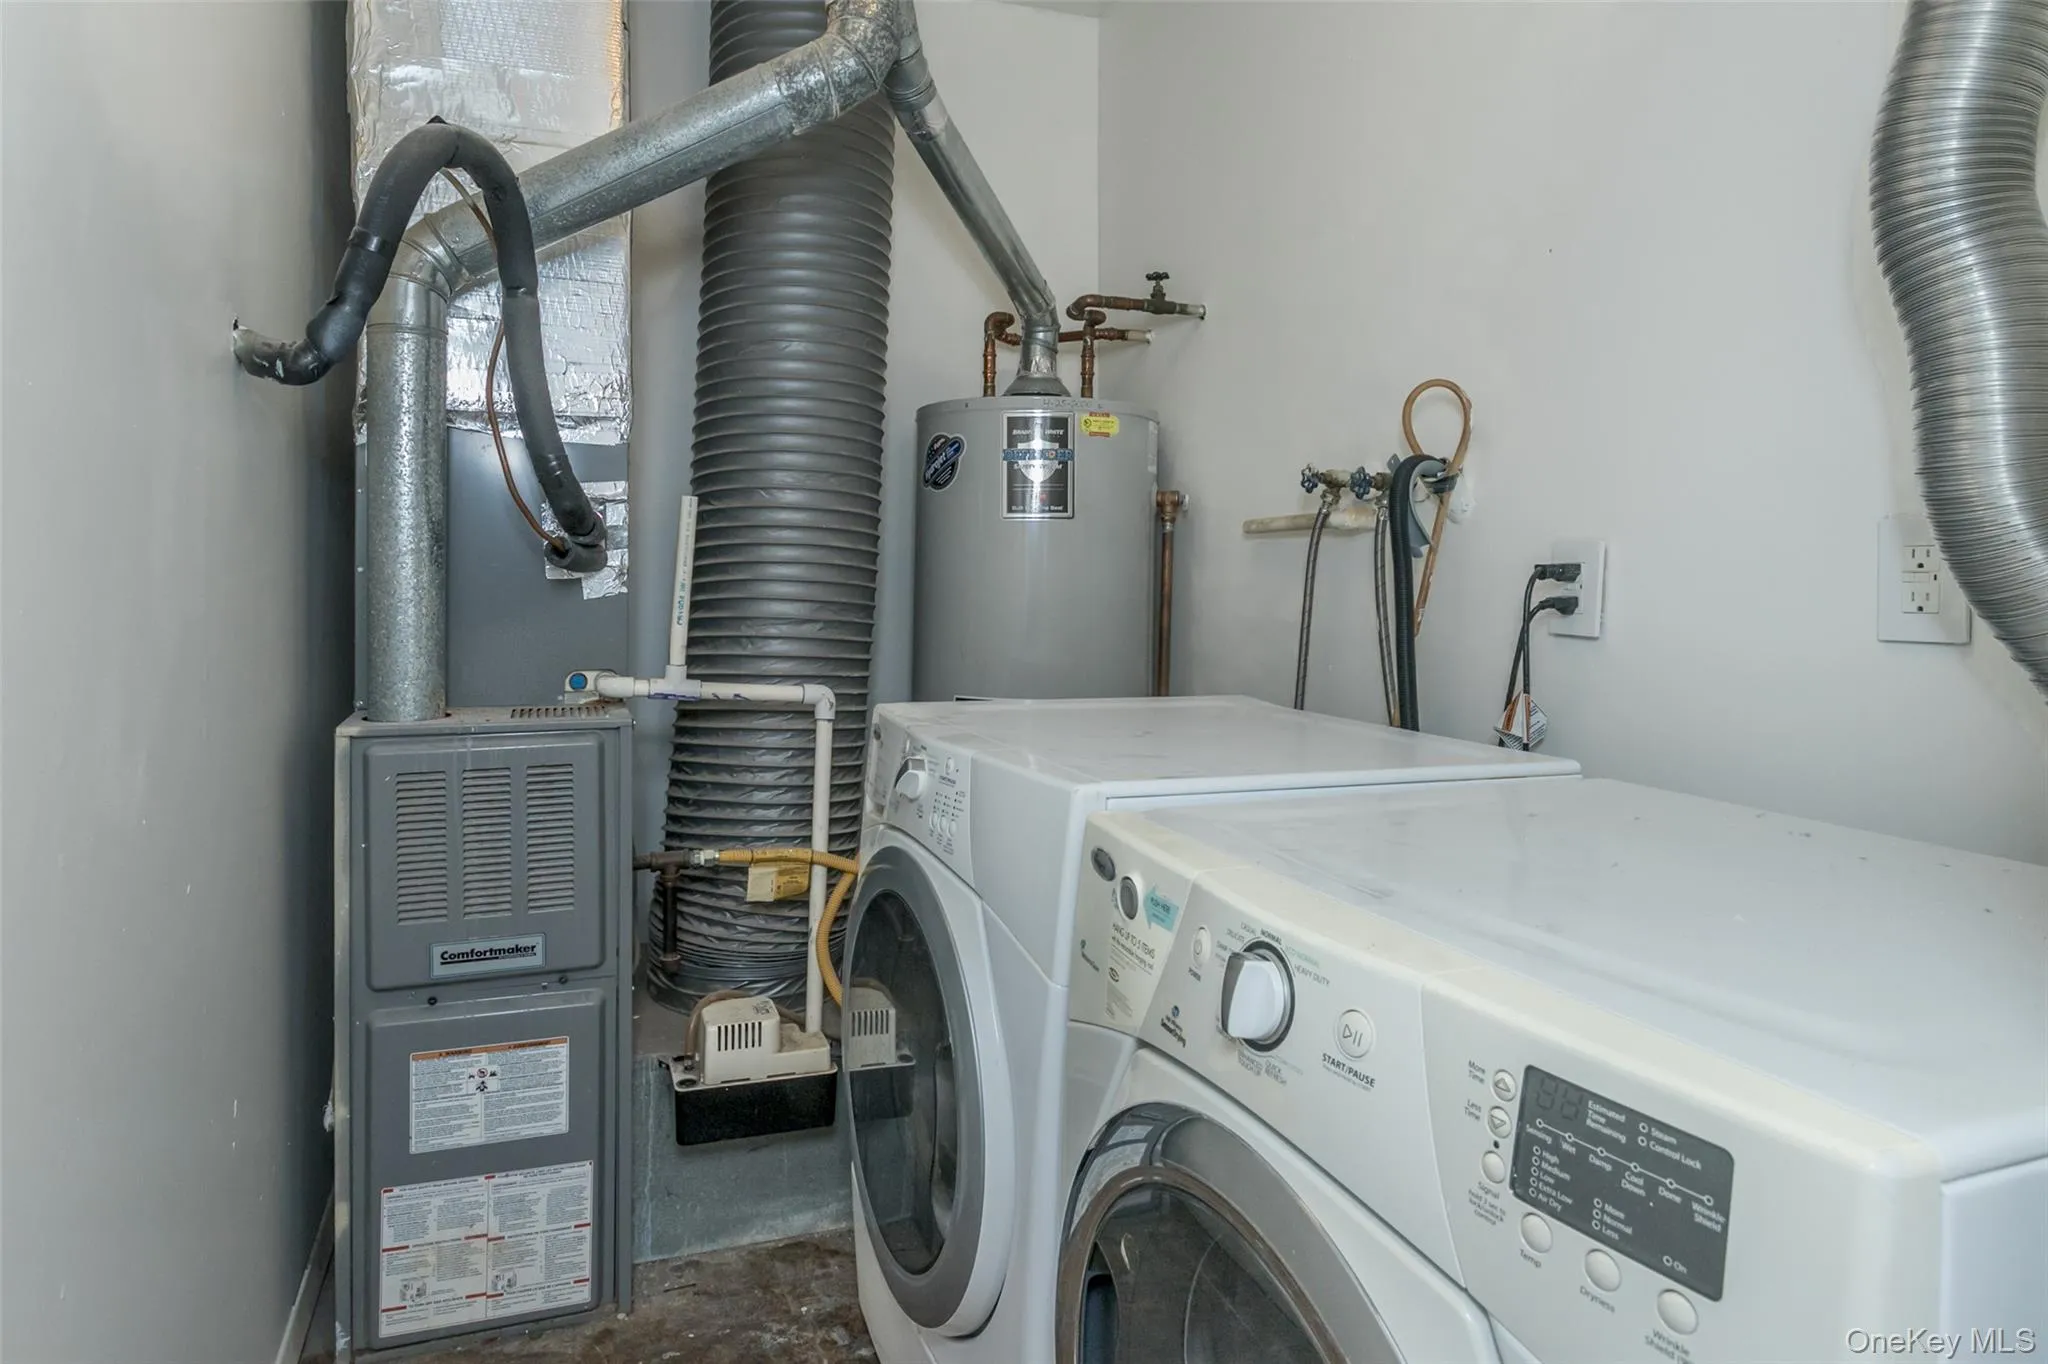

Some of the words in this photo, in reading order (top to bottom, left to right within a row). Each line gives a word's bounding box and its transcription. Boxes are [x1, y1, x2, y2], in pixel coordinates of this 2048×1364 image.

[1260, 929, 1282, 945] NORMAL
[440, 944, 536, 961] Comfortmaker
[1313, 973, 1330, 987] DUTY
[1322, 1053, 1375, 1088] START/PAUSE
[1468, 1060, 1486, 1075] More
[1469, 1070, 1485, 1084] Time
[1587, 1110, 1606, 1124] Time
[1588, 1100, 1626, 1122] Estimated
[1526, 1123, 1553, 1145] Sensing
[1586, 1118, 1626, 1143] Remaining
[1651, 1127, 1677, 1144] Steam
[1560, 1138, 1576, 1155] Wet
[1649, 1141, 1680, 1160] Control
[1681, 1154, 1702, 1170] Lock
[1542, 1150, 1560, 1165] High
[1589, 1154, 1612, 1171] Damp
[1540, 1171, 1555, 1185] Low
[1541, 1161, 1571, 1181] Medium
[1625, 1171, 1644, 1186] Cool
[1478, 1181, 1500, 1199] Signal
[1538, 1181, 1556, 1197] Extra
[1558, 1192, 1573, 1205] Low
[1621, 1179, 1646, 1197] Down
[1658, 1186, 1682, 1204] Done
[1549, 1199, 1563, 1212] Dry
[1604, 1203, 1625, 1220] More
[1691, 1201, 1726, 1223] Wrinkle
[1603, 1213, 1632, 1235] Normal
[1694, 1212, 1722, 1233] Shield
[1602, 1226, 1619, 1240] Less
[1519, 1249, 1542, 1268] Temp
[1673, 1261, 1688, 1275] On
[1580, 1285, 1616, 1313] Dryness
[1645, 1335, 1675, 1360] Shield
[1652, 1328, 1690, 1357] Wrinkle
